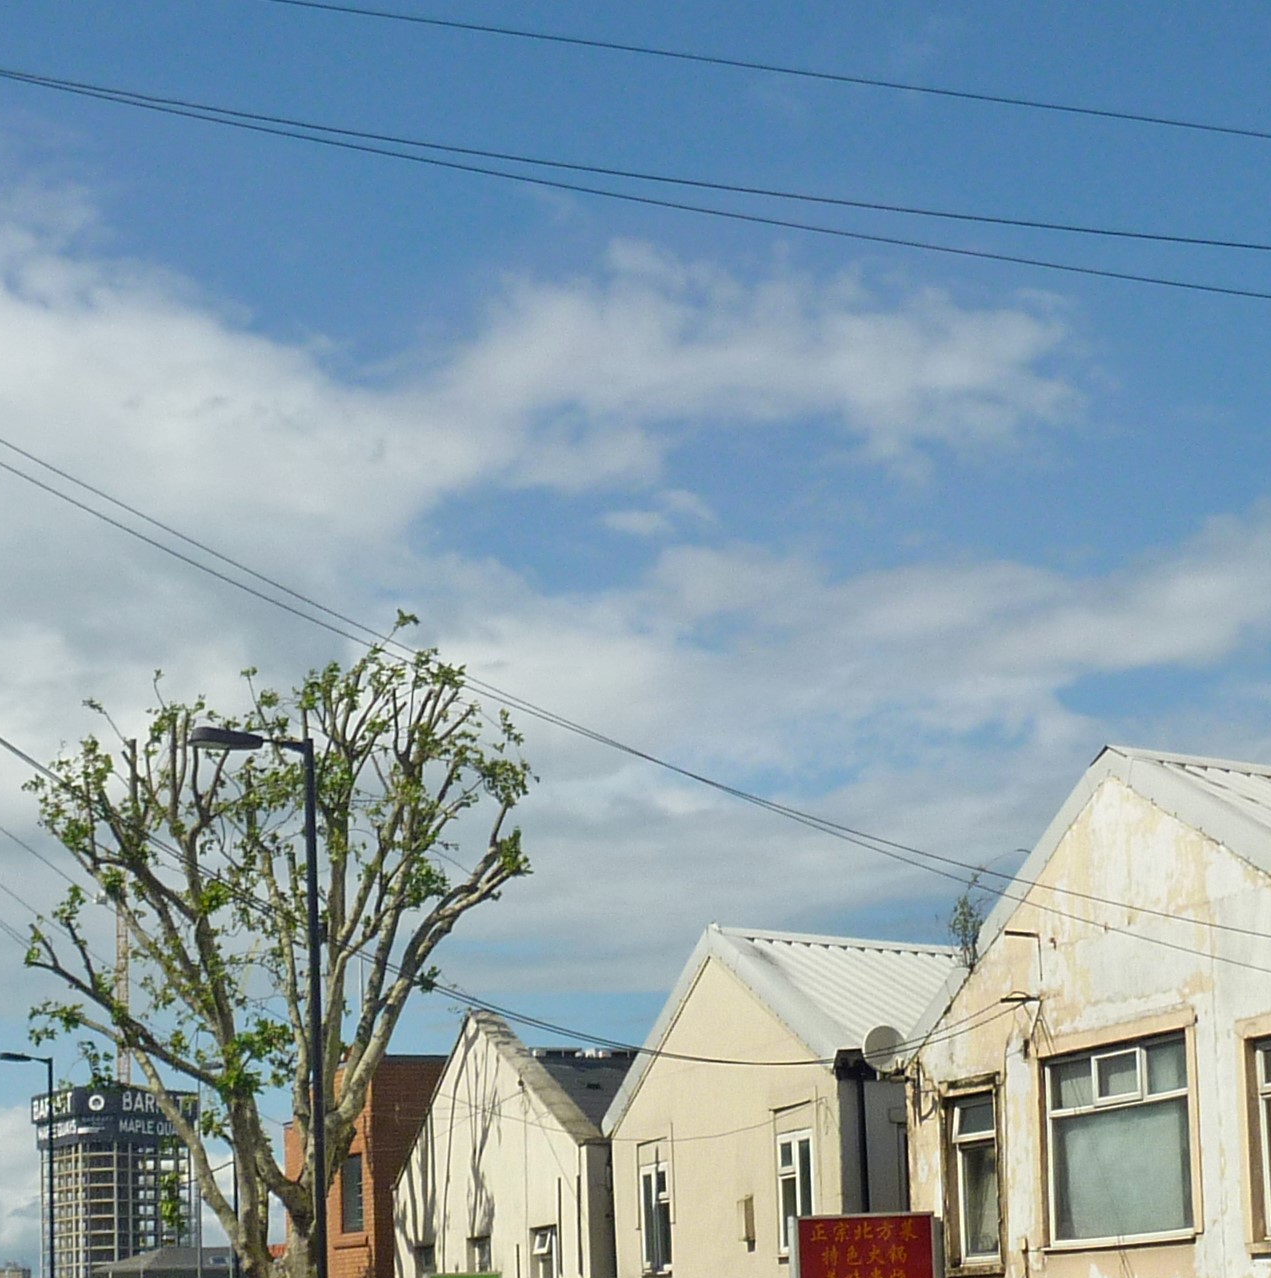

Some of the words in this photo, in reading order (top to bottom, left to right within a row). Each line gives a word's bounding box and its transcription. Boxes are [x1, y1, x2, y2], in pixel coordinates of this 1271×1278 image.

[121, 1090, 198, 1117] BARTT
[118, 1118, 154, 1135] MAPLE
[156, 1120, 183, 1136] QUA
[810, 1219, 920, 1243] 正宗北方菜
